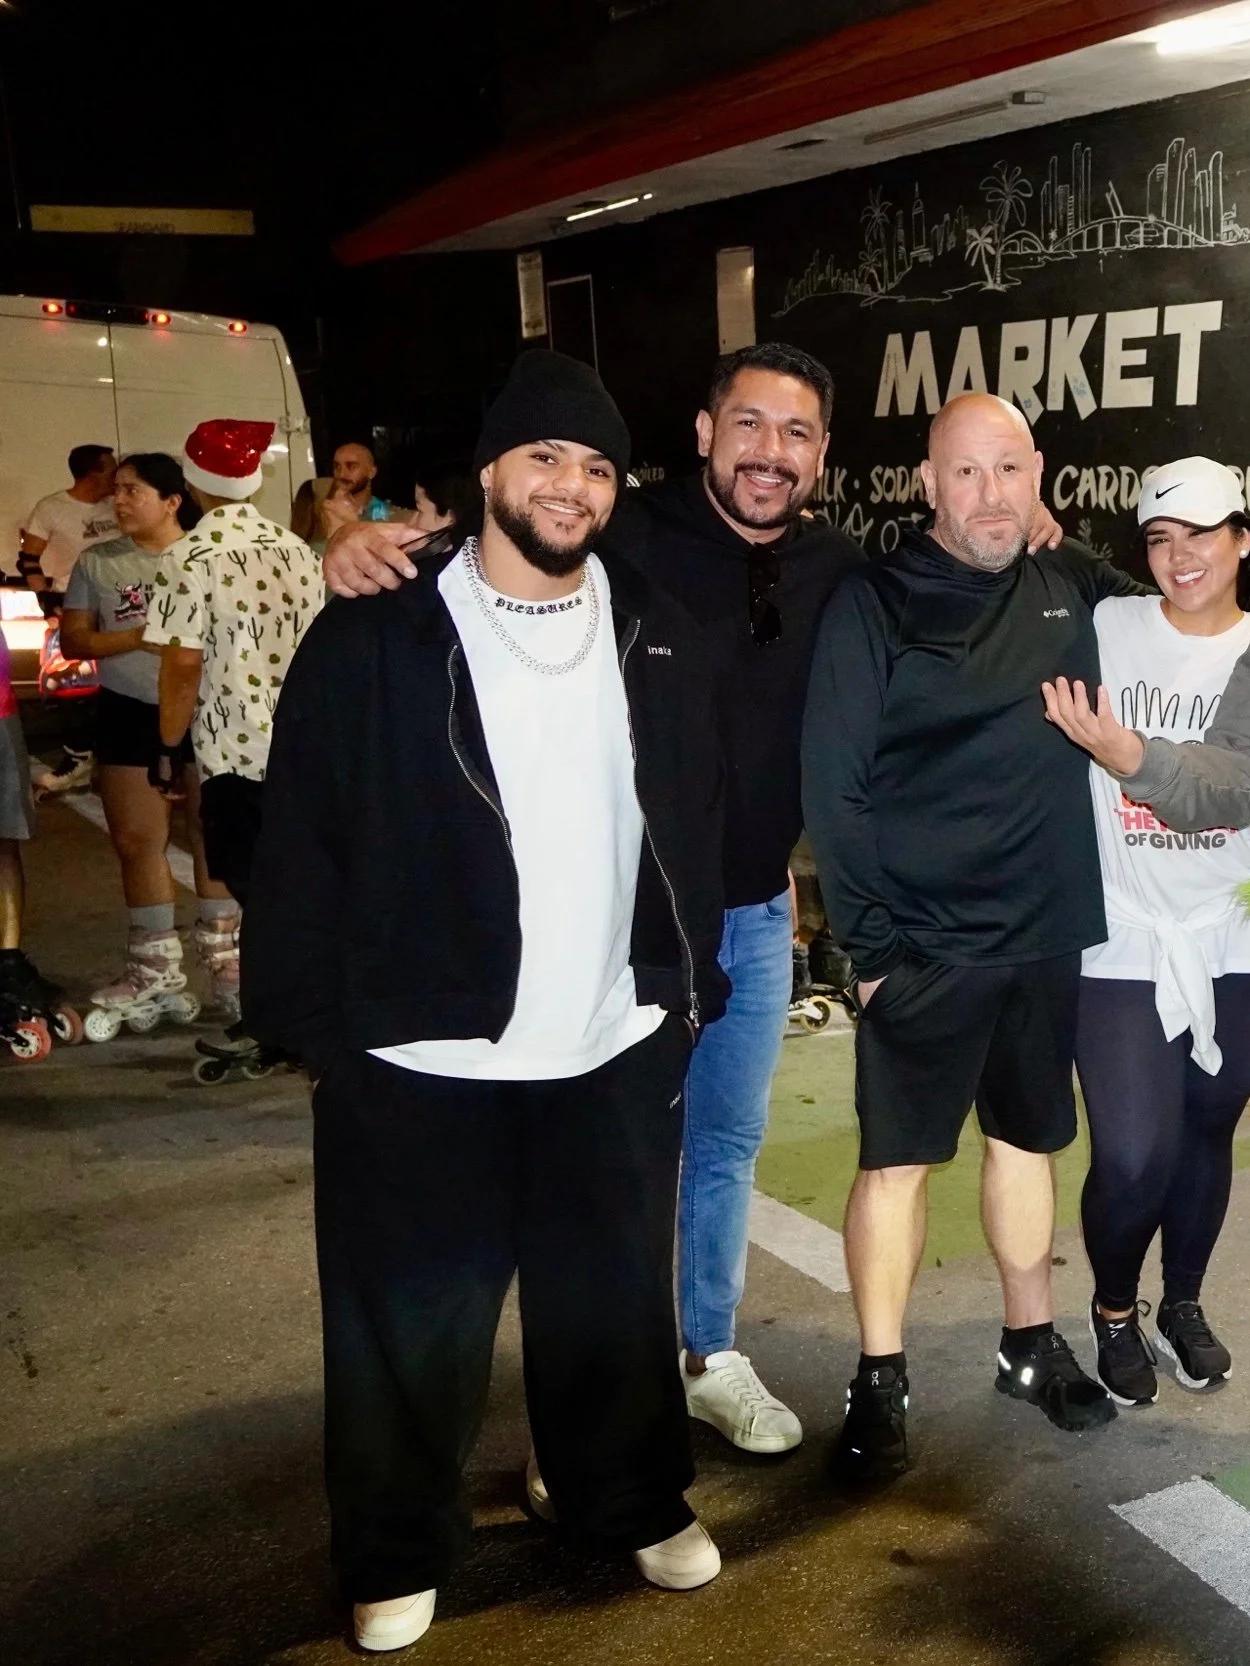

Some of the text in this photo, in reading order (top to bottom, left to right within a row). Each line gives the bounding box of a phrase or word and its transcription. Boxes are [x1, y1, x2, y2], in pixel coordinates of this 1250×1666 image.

[874, 300, 1223, 427] MARKET
[813, 466, 848, 503] ILK
[494, 596, 583, 615] PLEASURES
[1124, 832, 1227, 850] OF GIVING
